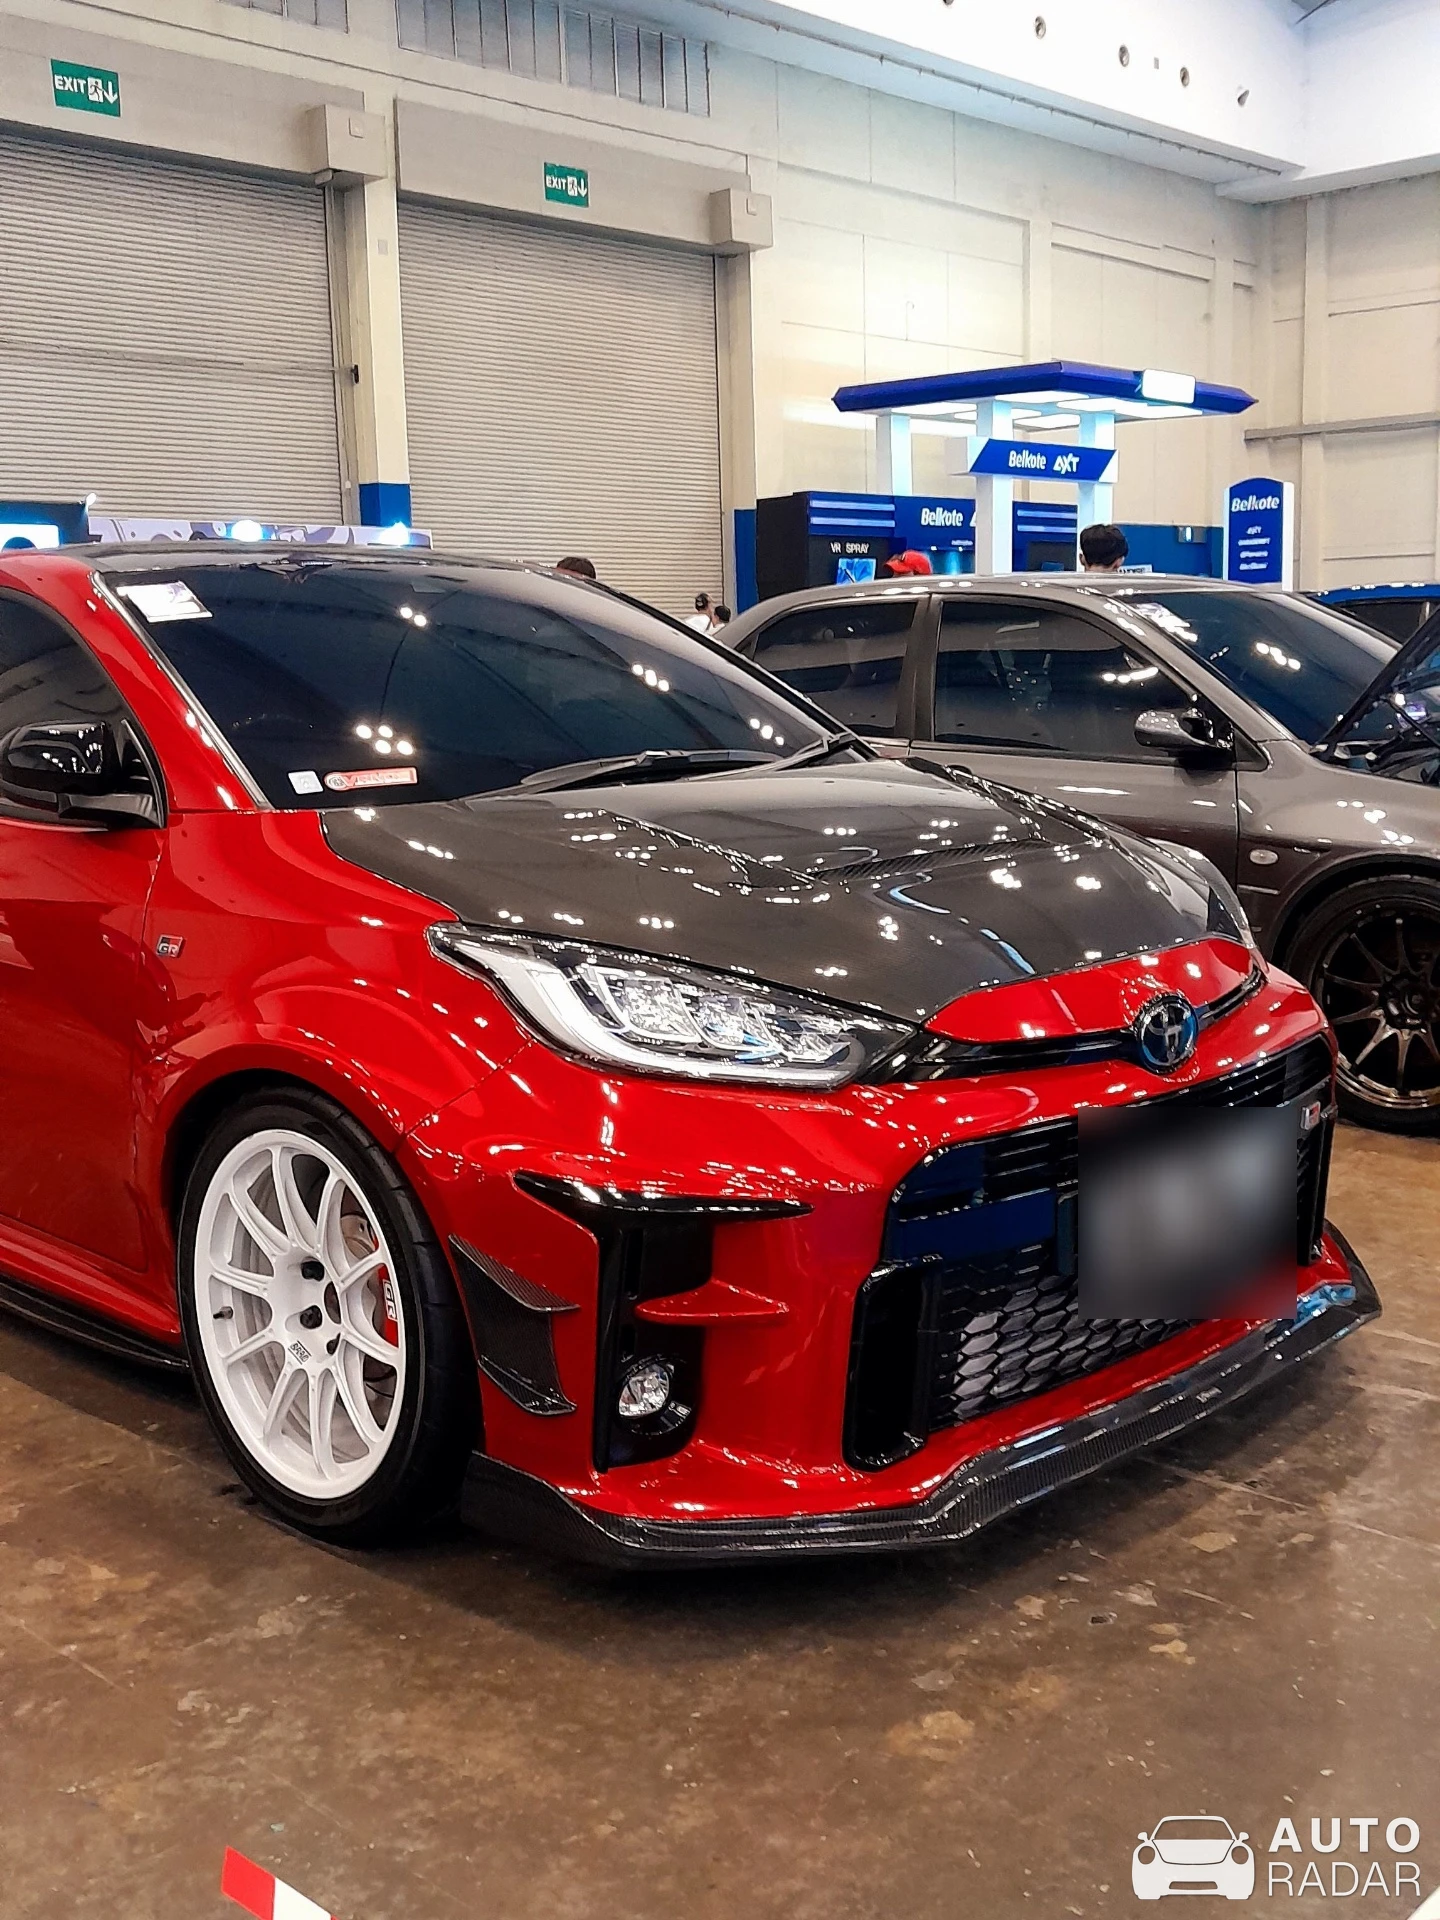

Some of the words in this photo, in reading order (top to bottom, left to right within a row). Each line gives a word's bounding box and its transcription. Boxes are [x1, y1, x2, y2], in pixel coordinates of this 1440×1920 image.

[54, 74, 86, 94] EXIT
[546, 175, 567, 190] EXIT
[1008, 449, 1046, 469] Belkote
[1231, 495, 1280, 512] Belkote
[921, 507, 963, 526] Belkote
[830, 542, 841, 553] VR
[845, 542, 869, 553] SPRAY
[384, 1282, 397, 1319] GR
